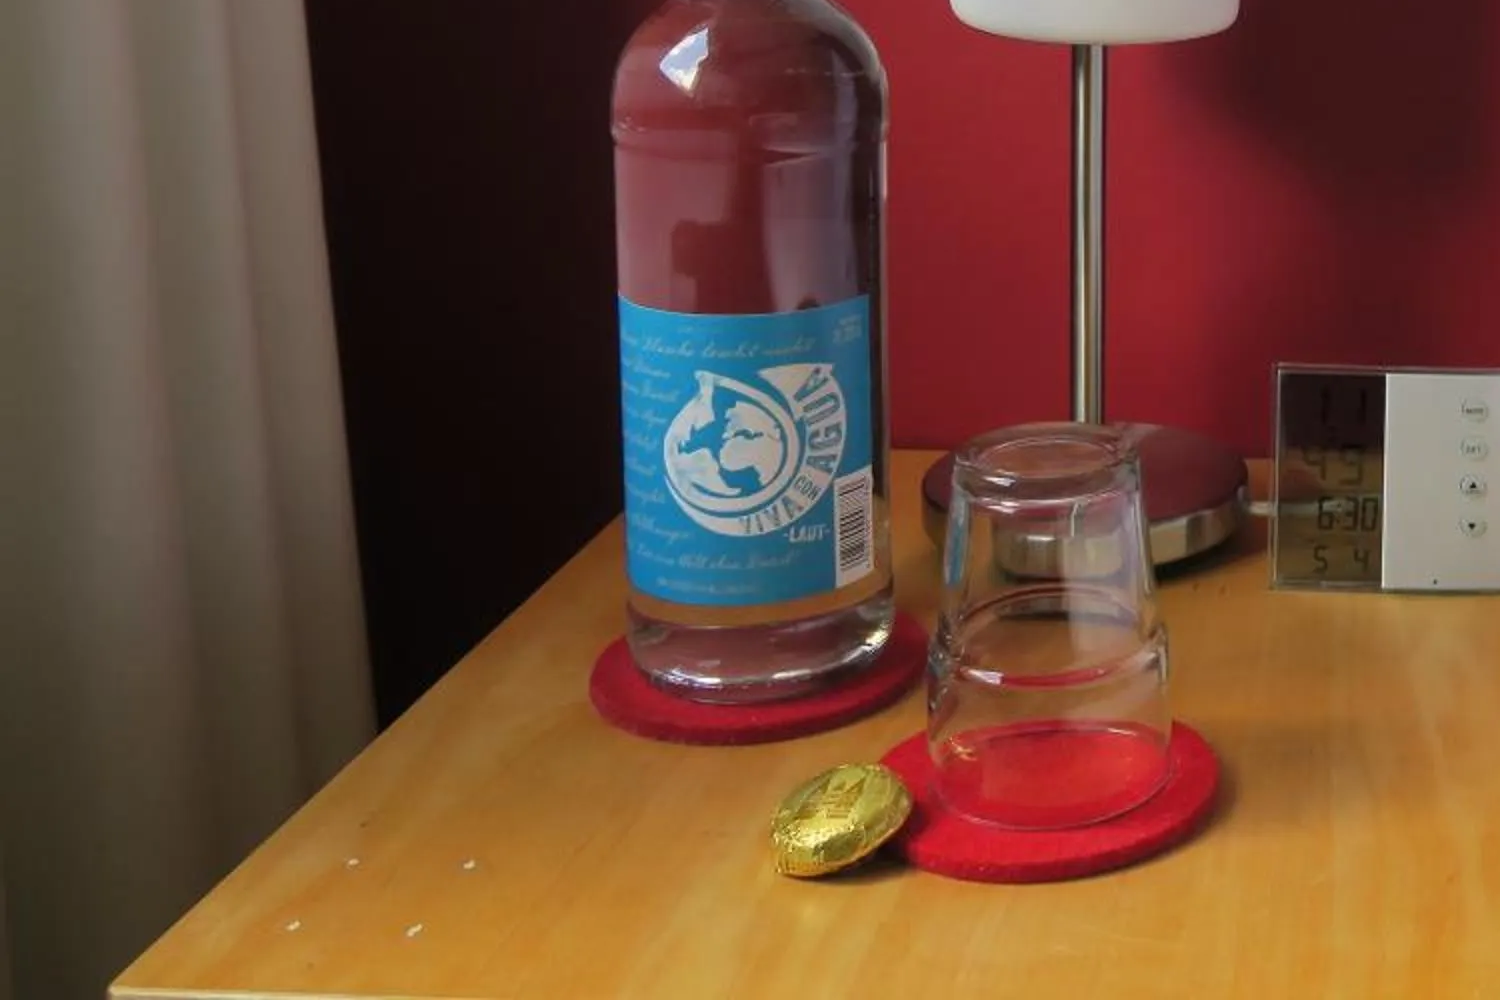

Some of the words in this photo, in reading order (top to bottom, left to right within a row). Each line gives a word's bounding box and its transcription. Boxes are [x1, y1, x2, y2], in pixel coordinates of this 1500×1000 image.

[793, 367, 843, 475] AGUA
[793, 474, 822, 501] CON
[738, 495, 804, 535] VIVA
[1317, 495, 1379, 531] 6:30
[1353, 549, 1371, 573] 4
